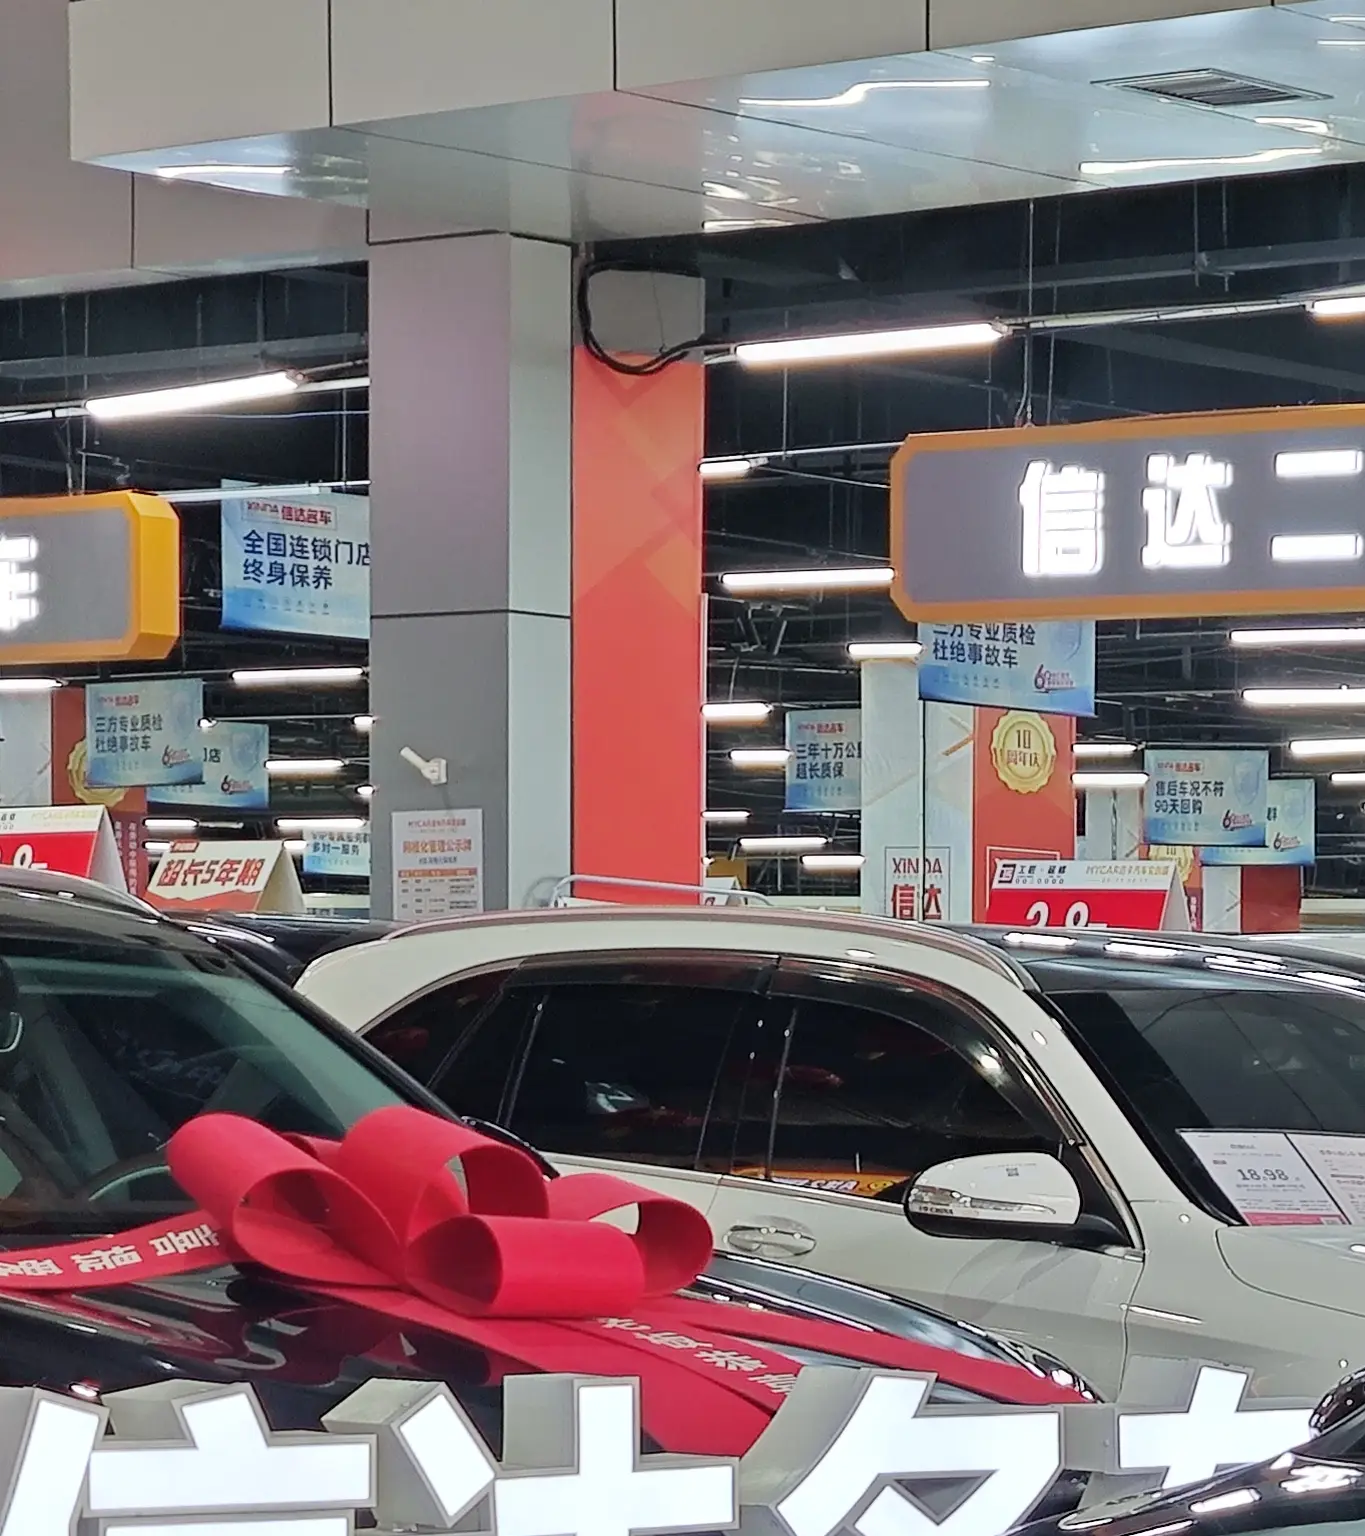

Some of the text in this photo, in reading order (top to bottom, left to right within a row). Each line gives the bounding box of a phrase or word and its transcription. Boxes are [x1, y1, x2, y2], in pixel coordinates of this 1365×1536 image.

[243, 529, 370, 567] 全国连锁门店
[243, 560, 333, 591] 终身保养
[932, 638, 1019, 668] 杜绝事故车
[95, 713, 163, 733] 三方专业质检
[1016, 729, 1032, 749] 10
[796, 761, 845, 780] 超长质保
[1237, 1168, 1289, 1181] 18.98
